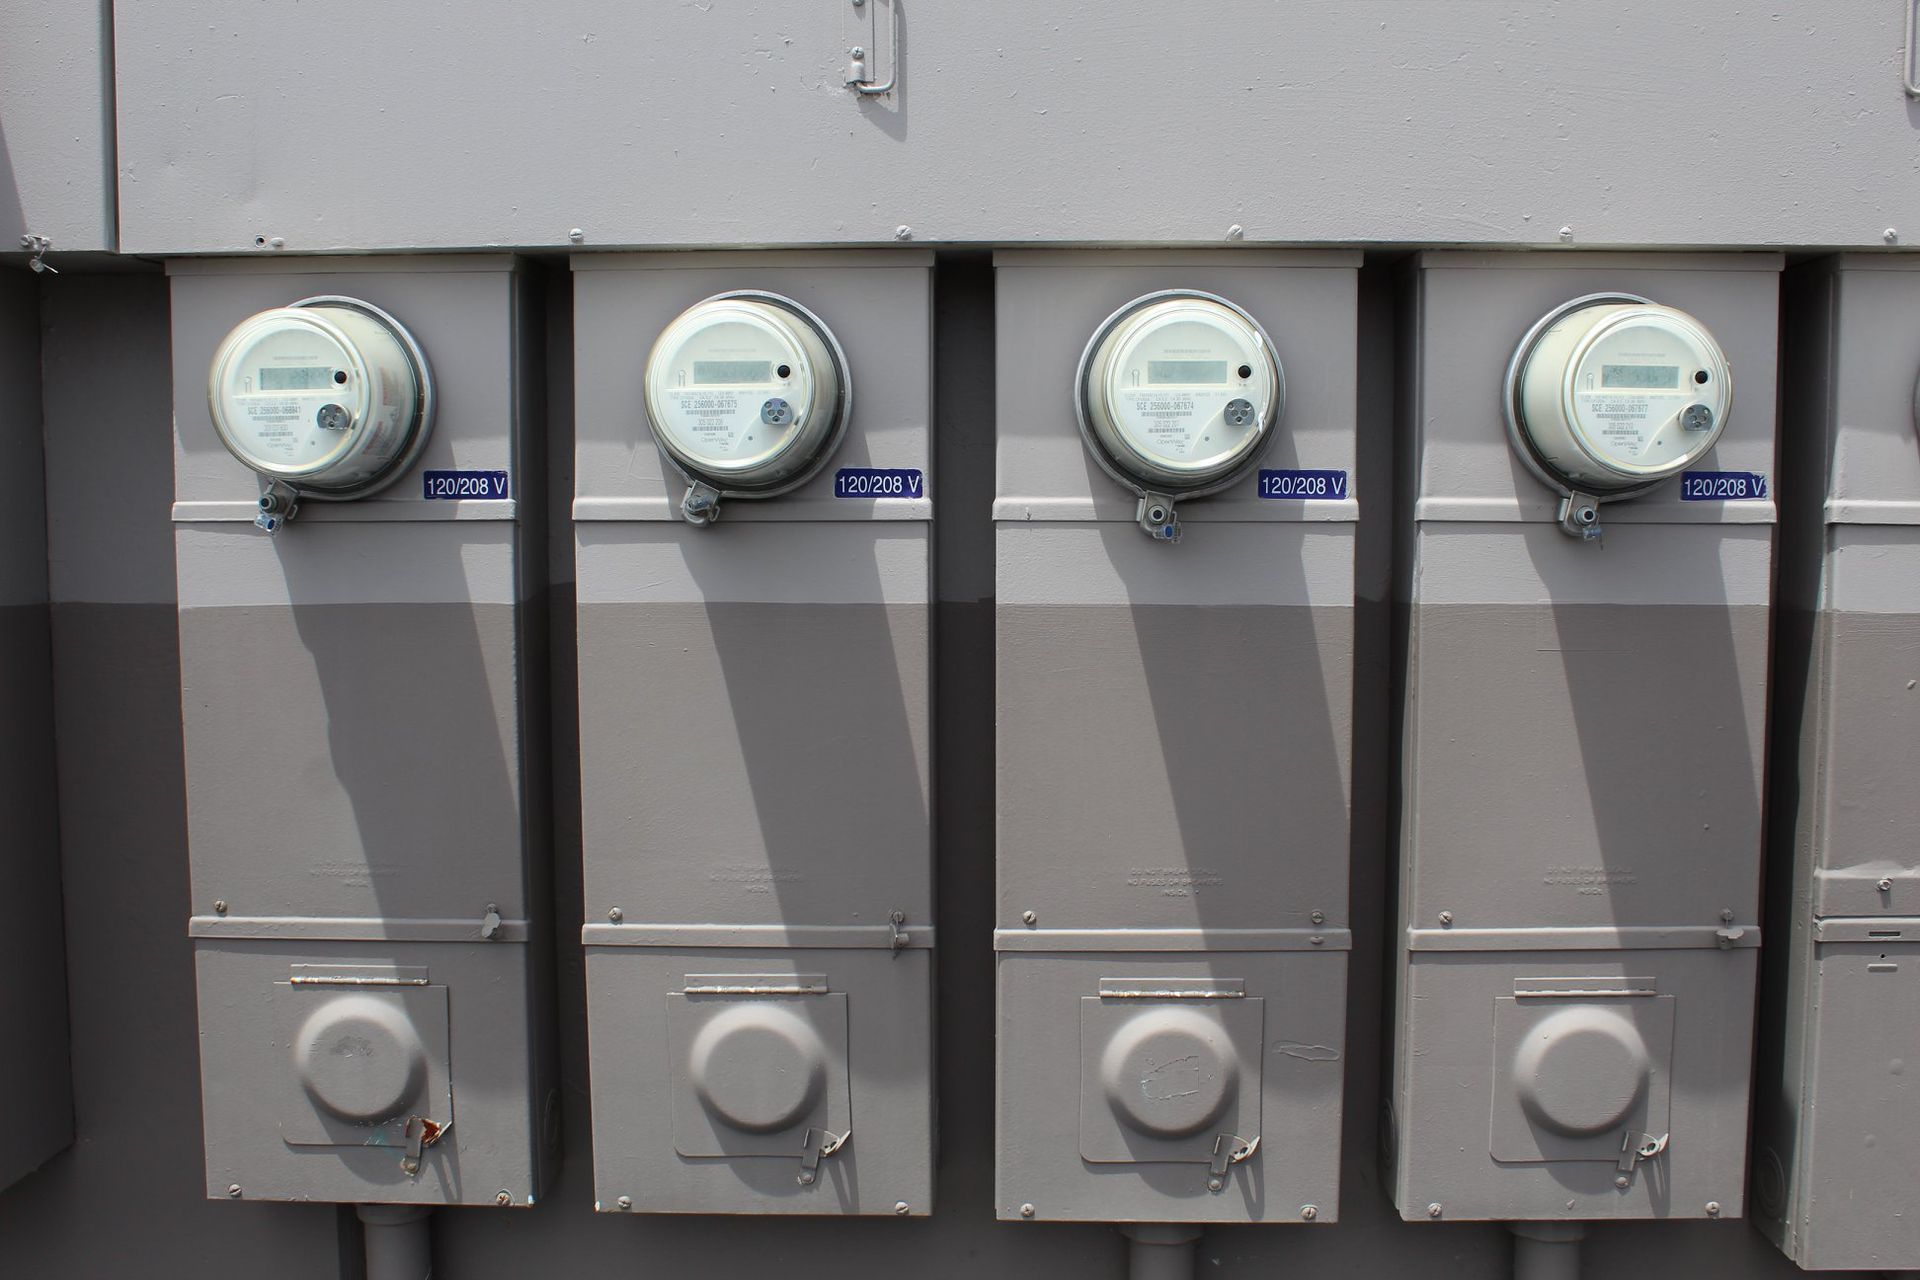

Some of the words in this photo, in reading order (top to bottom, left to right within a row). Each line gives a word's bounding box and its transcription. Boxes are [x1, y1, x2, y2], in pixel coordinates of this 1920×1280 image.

[427, 478, 489, 495] 120/208
[493, 477, 506, 494] V
[839, 476, 903, 493] 120/208
[907, 476, 920, 493] V
[1262, 477, 1327, 495] 120/208
[1331, 477, 1344, 495] V
[1684, 479, 1747, 496] 120/208
[1751, 479, 1764, 496] V
